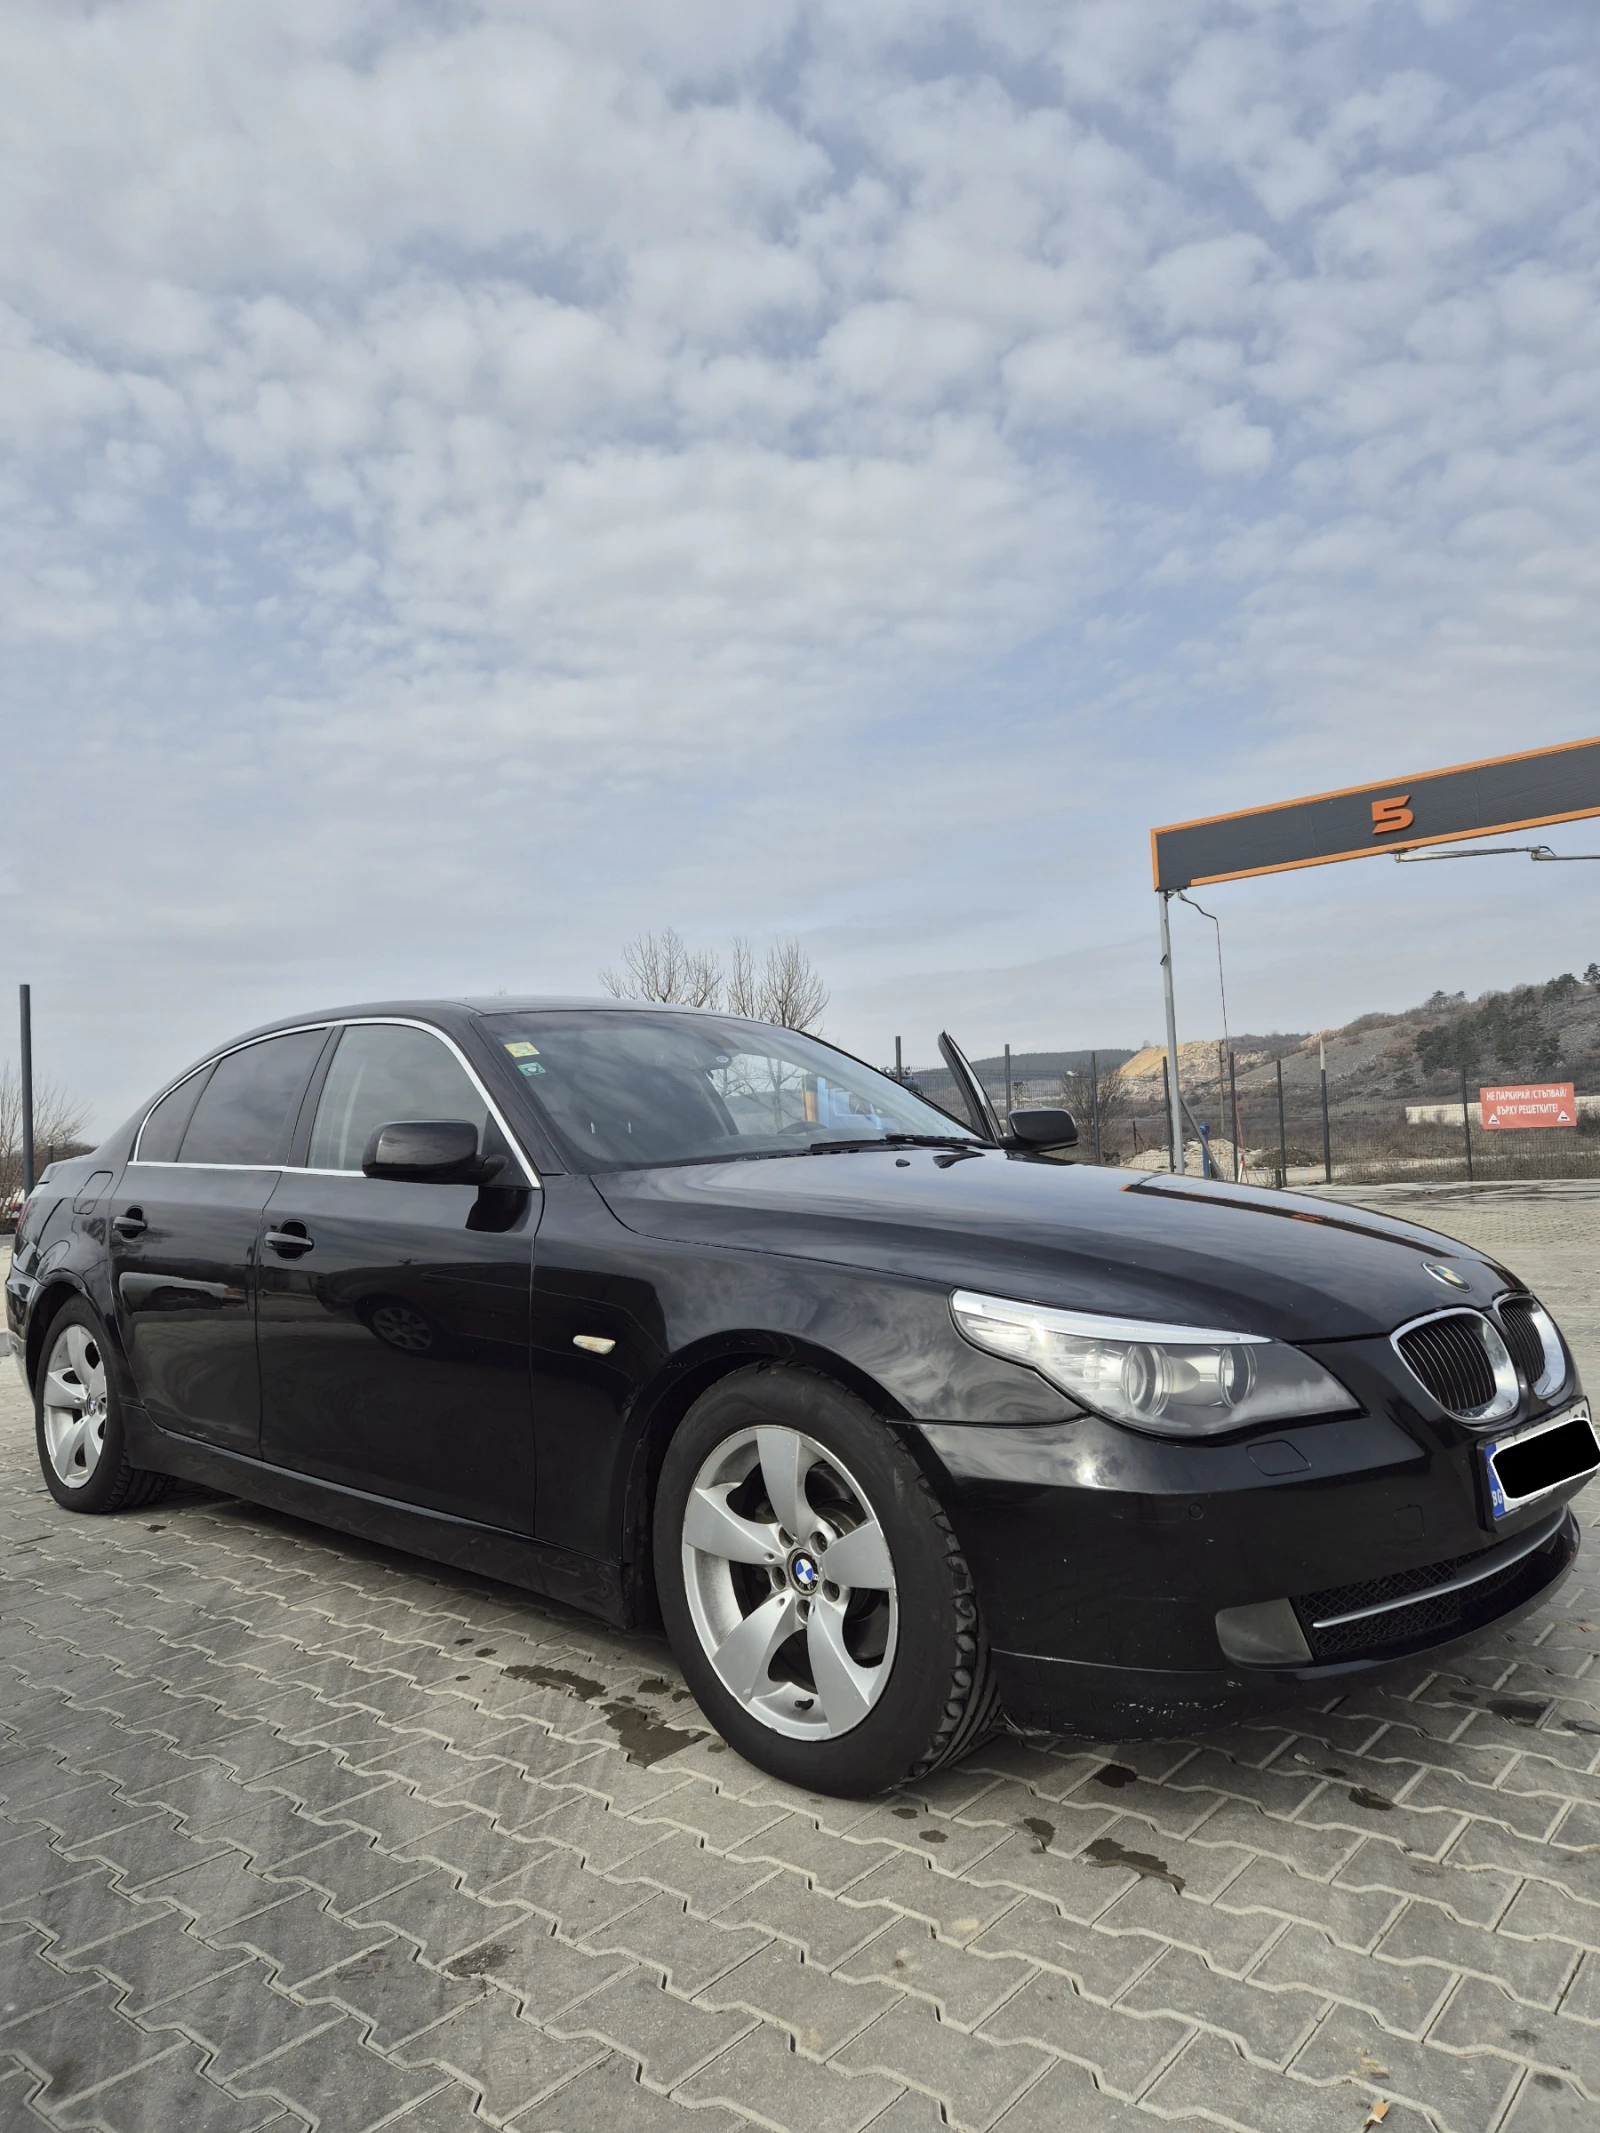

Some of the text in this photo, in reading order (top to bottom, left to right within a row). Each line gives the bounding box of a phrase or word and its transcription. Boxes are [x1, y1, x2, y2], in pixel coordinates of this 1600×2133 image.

[1371, 795, 1414, 834] 5
[1486, 1091, 1495, 1101] НЕ
[1496, 1089, 1530, 1101] ПАРКИРАЙ
[1496, 1103, 1558, 1116] ВЪРХУ РЕШЕТКИТЕ!
[1491, 1488, 1503, 1507] BG
